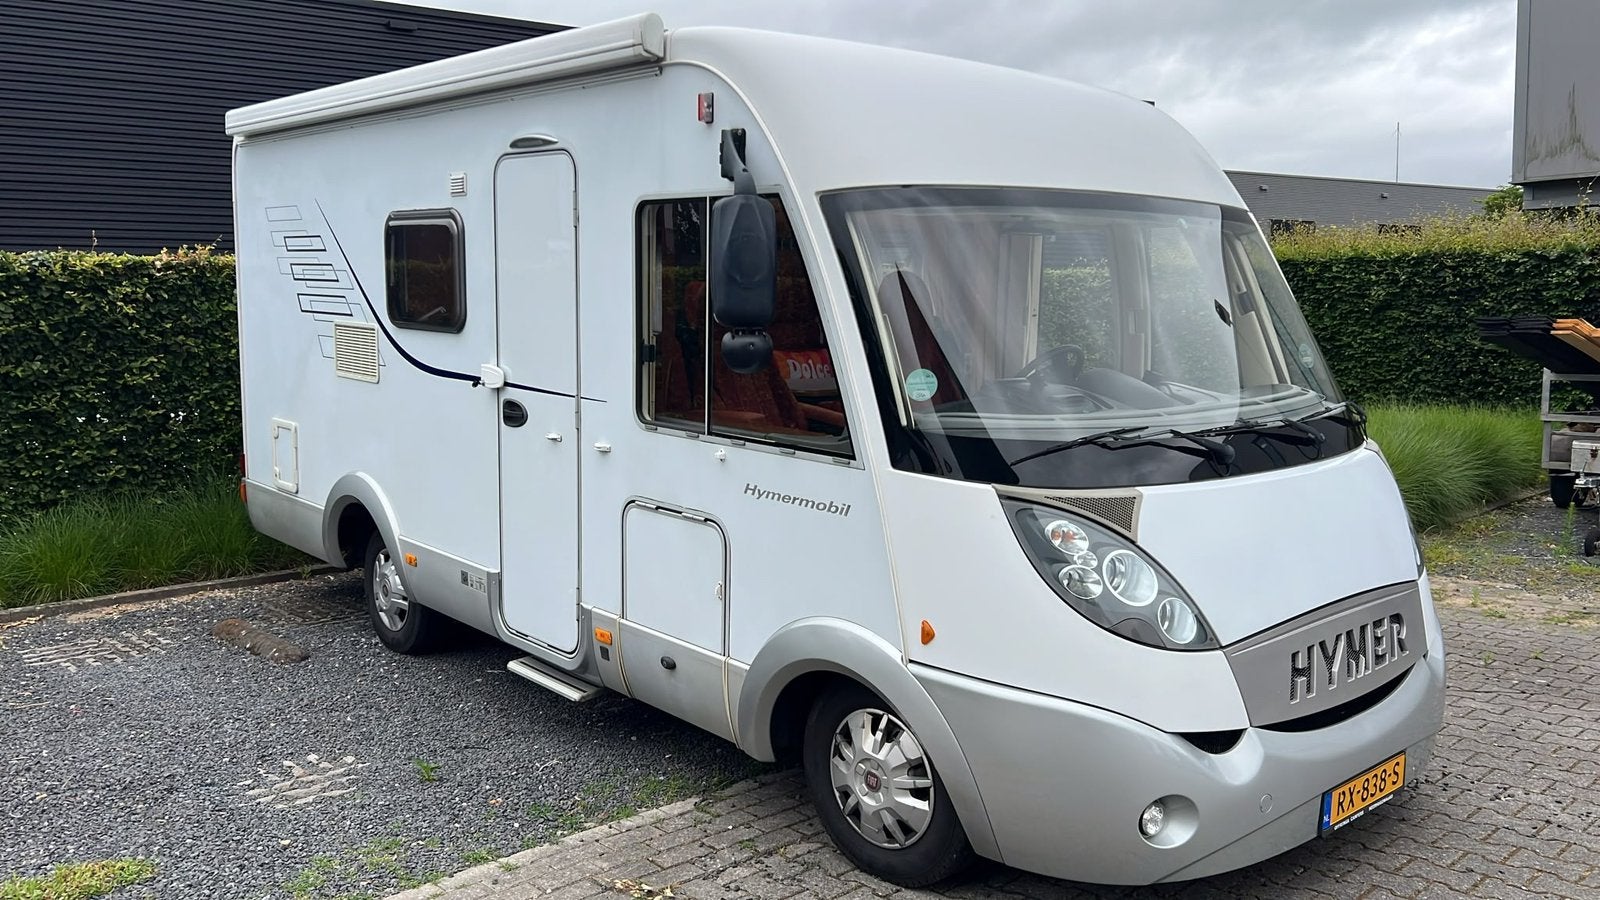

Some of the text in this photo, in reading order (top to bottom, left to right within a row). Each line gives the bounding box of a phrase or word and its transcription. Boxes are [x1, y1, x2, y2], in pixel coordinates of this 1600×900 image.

[787, 359, 831, 379] Dolce
[743, 483, 852, 517] Hymermobil
[1290, 612, 1410, 705] HYMER
[1336, 761, 1400, 817] RX-838-S
